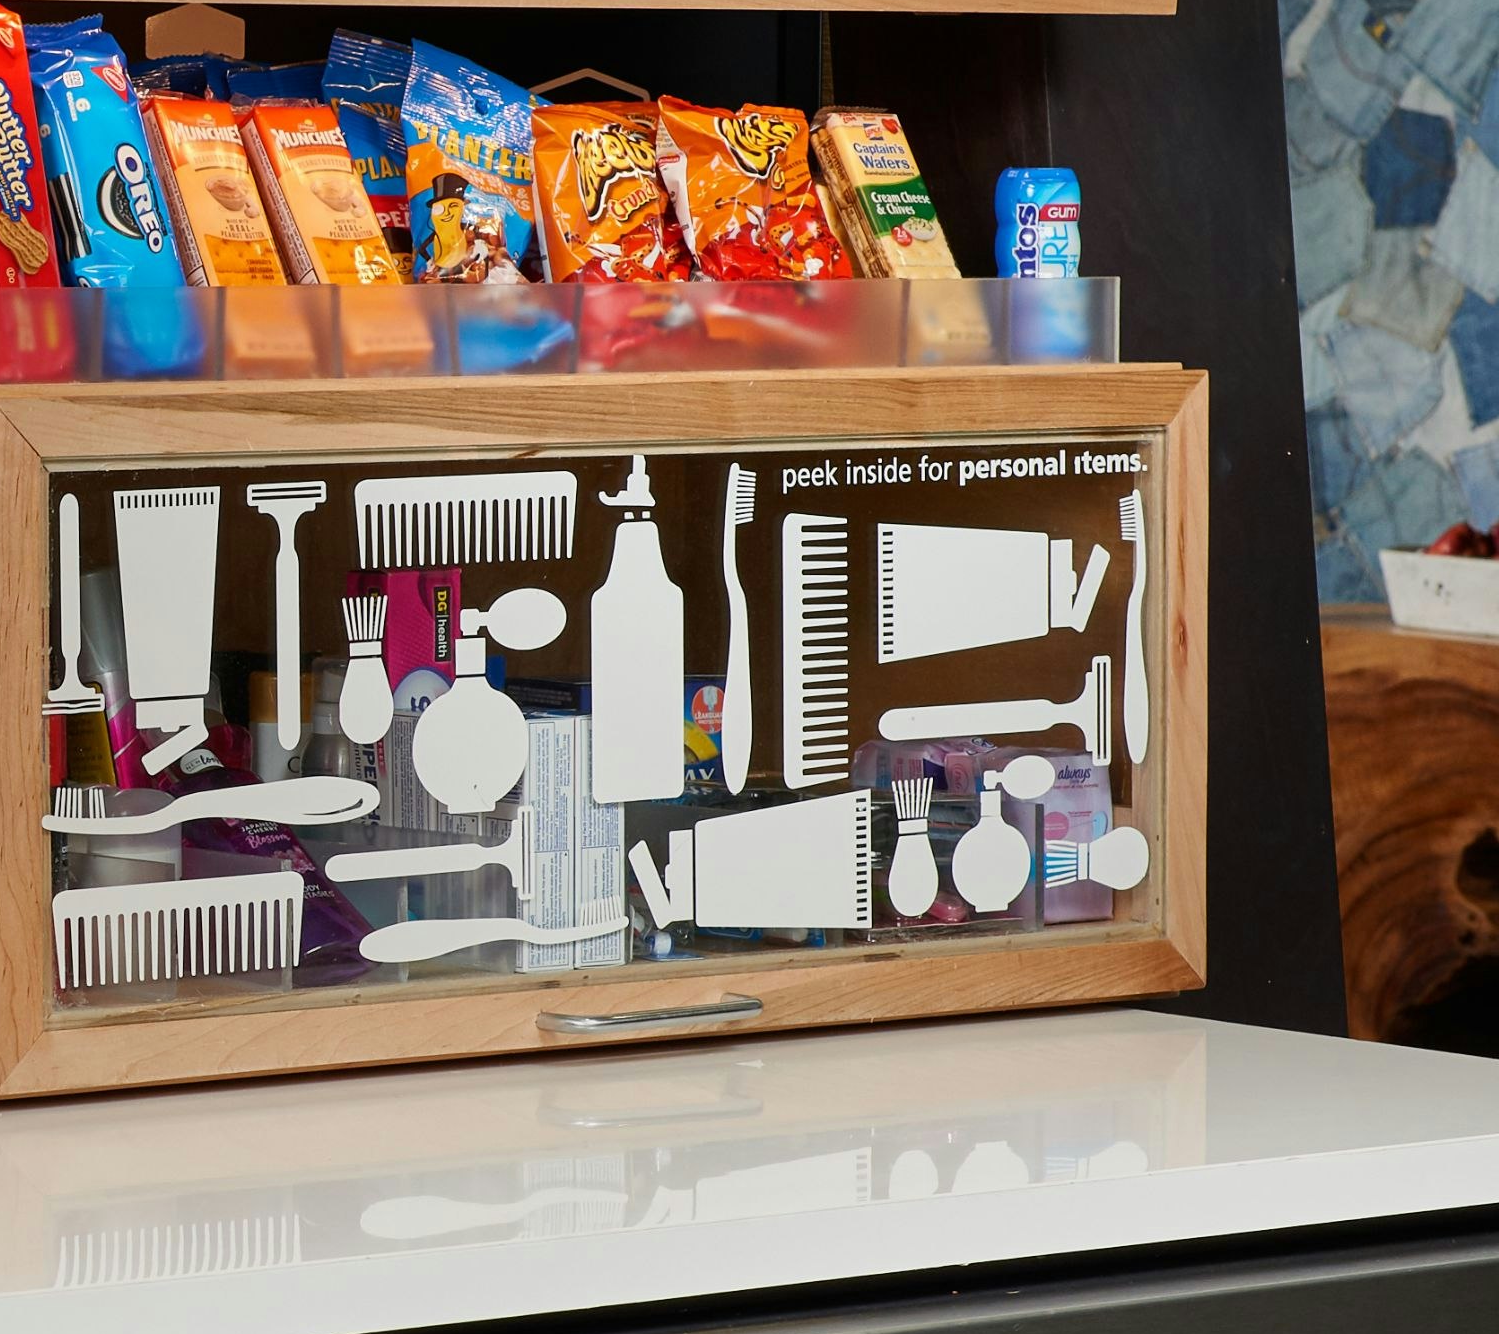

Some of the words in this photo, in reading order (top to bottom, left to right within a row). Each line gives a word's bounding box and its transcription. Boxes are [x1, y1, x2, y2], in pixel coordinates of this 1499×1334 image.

[170, 120, 242, 144] MUNCHIES
[271, 128, 347, 149] MUNCHIES
[853, 142, 905, 155] Captain's
[858, 154, 910, 170] Wafers
[114, 143, 164, 254] OREO
[871, 191, 901, 205] Cream
[901, 190, 931, 205] Cheese
[876, 205, 886, 215] &
[887, 202, 916, 216] Chives
[1047, 206, 1078, 219] GUM
[782, 459, 839, 494] peek
[846, 457, 912, 485] inside
[918, 455, 953, 481] for
[959, 450, 1066, 486] personal
[436, 589, 448, 613] DG
[436, 618, 448, 658] health
[1057, 765, 1092, 782] always
[247, 826, 279, 836] CHERRY
[245, 833, 291, 849] Blossom
